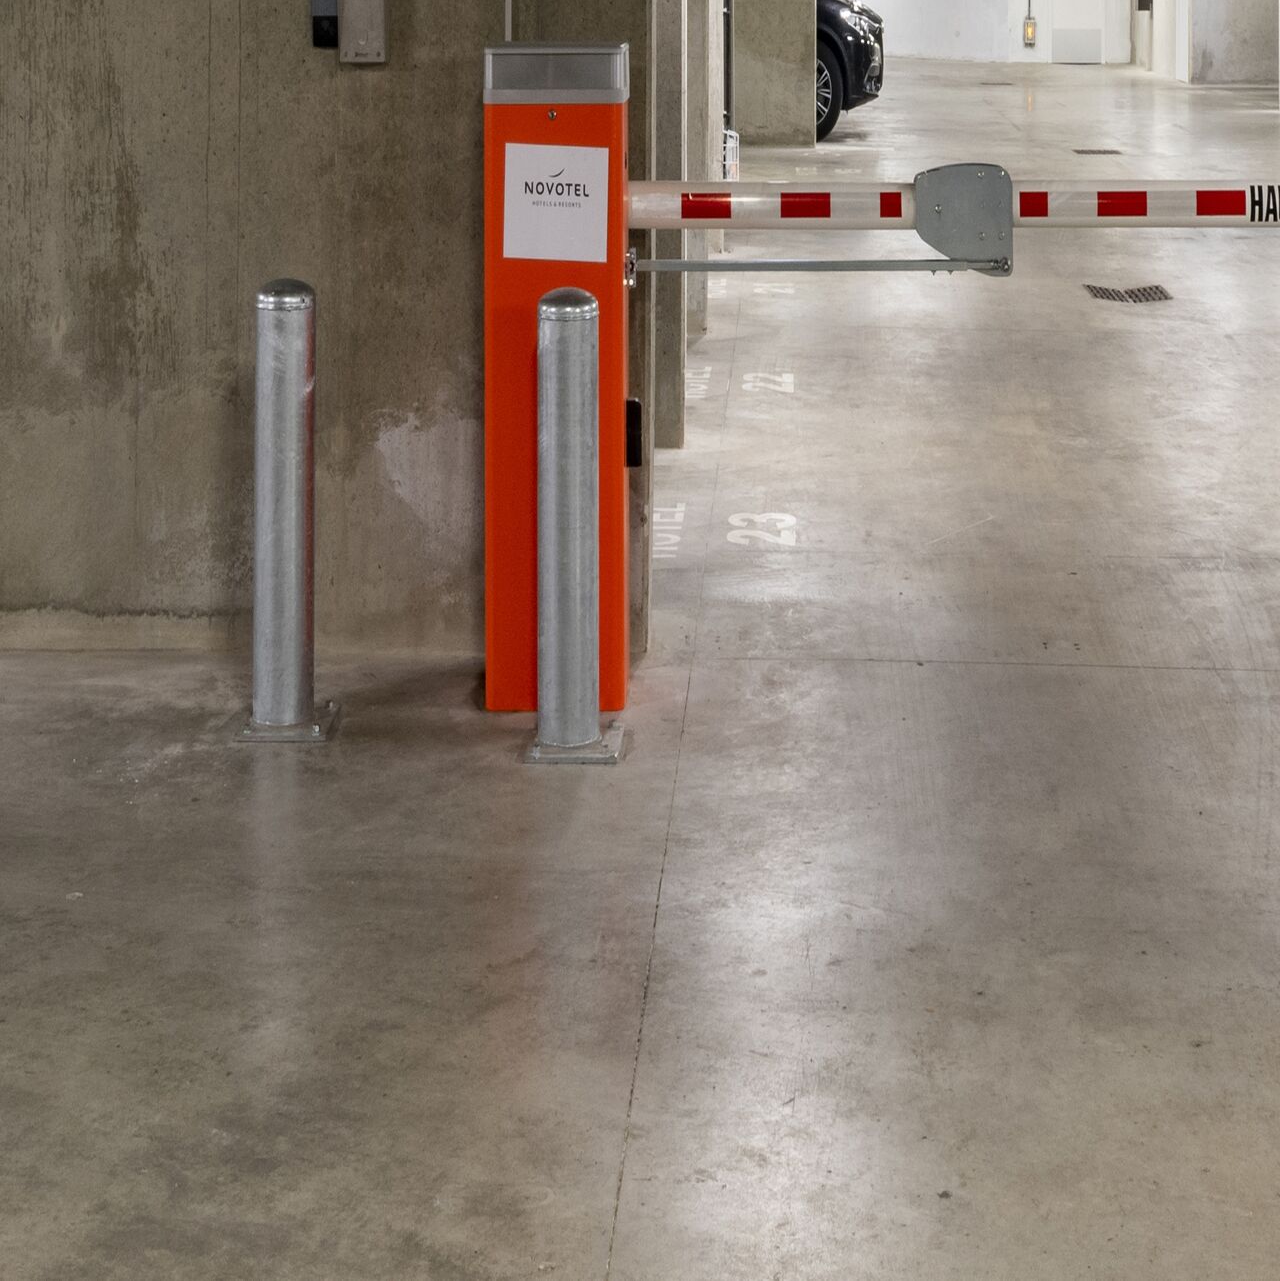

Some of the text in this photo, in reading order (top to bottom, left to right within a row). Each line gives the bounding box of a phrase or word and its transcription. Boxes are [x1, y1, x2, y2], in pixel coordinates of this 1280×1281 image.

[524, 181, 590, 198] NOVOTEL
[741, 372, 795, 394] 22
[726, 512, 797, 547] 23
